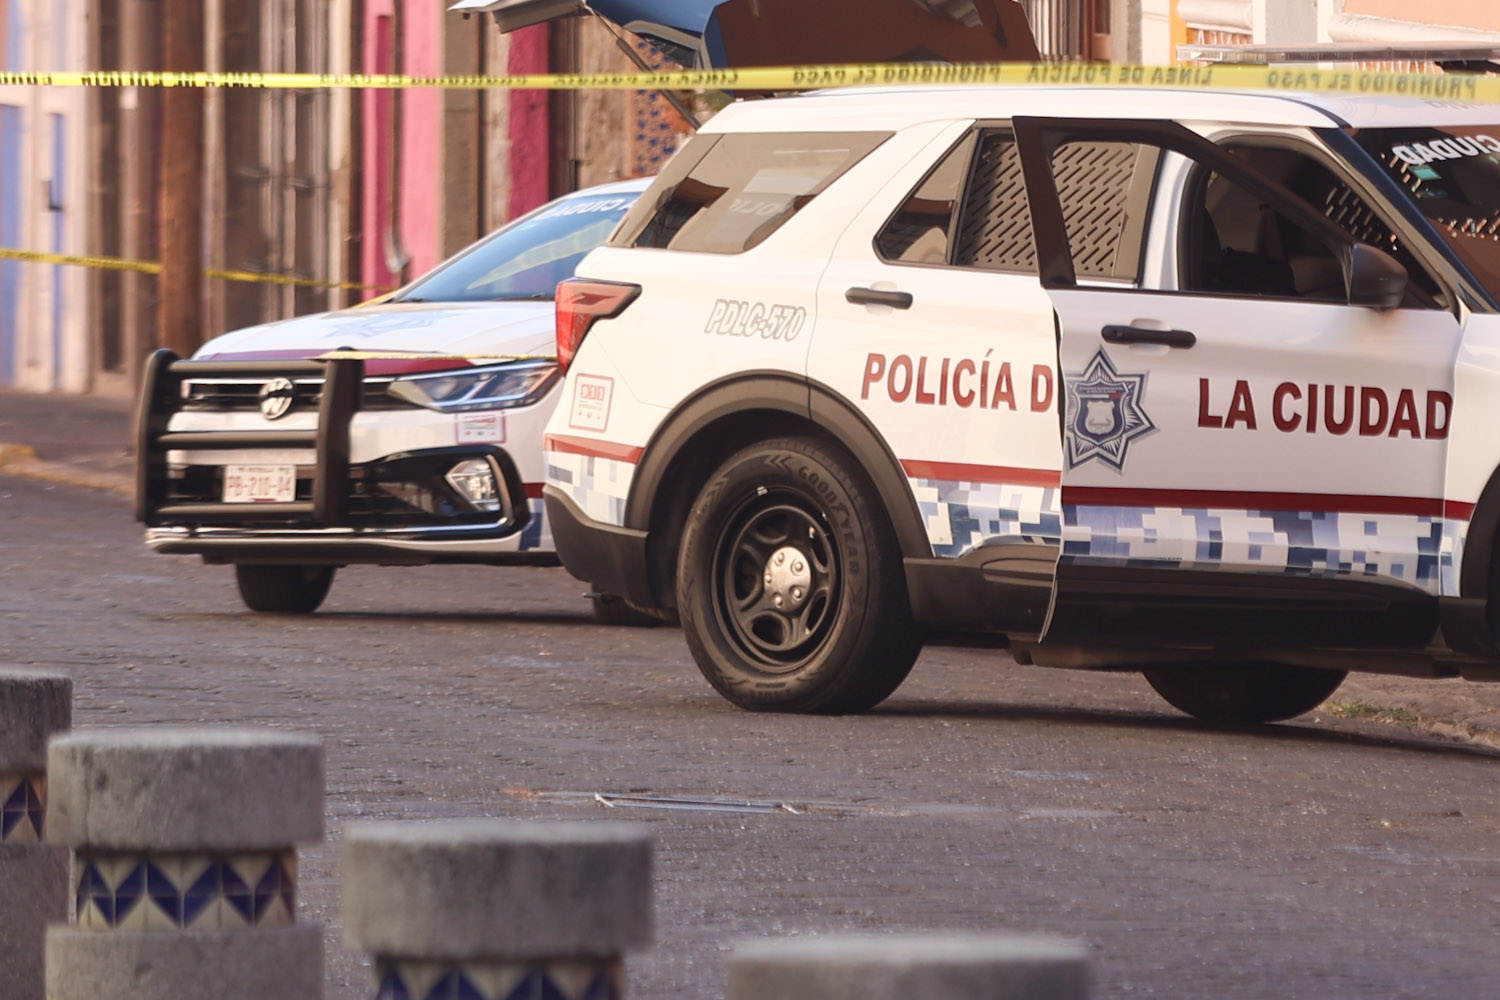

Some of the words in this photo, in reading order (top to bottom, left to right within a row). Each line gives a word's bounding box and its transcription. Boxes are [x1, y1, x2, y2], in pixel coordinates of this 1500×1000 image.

[705, 298, 807, 342] PDLC-570
[580, 384, 606, 401] 911
[860, 348, 1014, 413] POLICÍA
[1197, 377, 1258, 431] LA
[1272, 381, 1454, 441] CIUDAD
[797, 466, 860, 577] GOODYEAR
